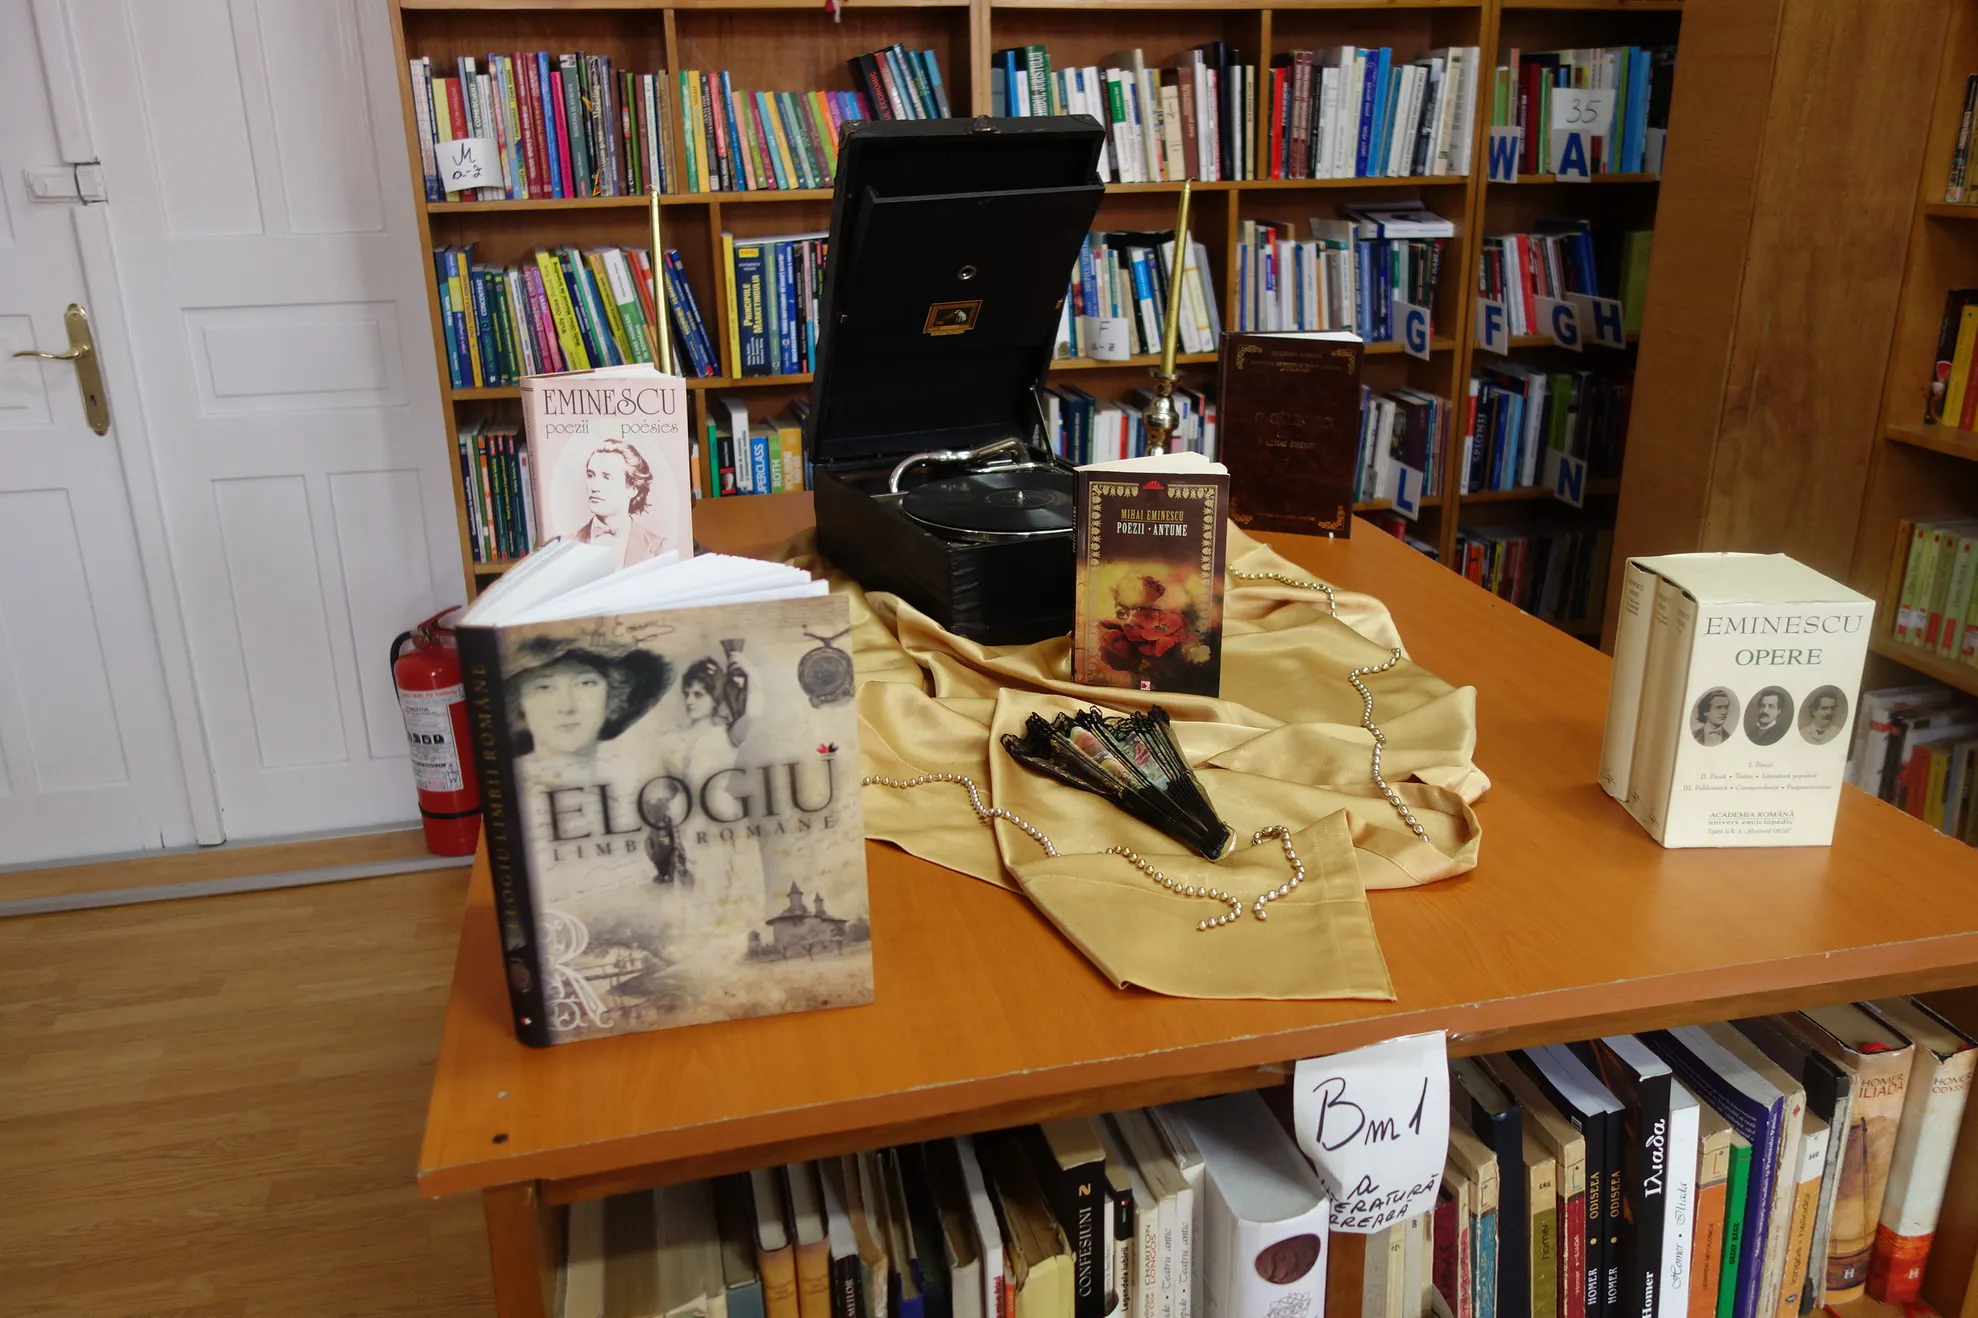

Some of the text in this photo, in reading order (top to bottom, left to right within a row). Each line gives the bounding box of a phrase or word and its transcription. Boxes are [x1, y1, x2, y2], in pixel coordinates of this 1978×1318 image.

[1566, 98, 1602, 123] 35
[1489, 136, 1518, 180] W
[1558, 132, 1588, 177] A
[476, 278, 487, 316] CONCENTRAT
[751, 274, 763, 334] MARKETINGULUI
[1406, 310, 1426, 353] G
[1485, 304, 1502, 346] F
[1552, 305, 1578, 346] G
[1592, 301, 1623, 344] H
[543, 387, 677, 416] EMINESCU
[545, 419, 679, 441] poezii poésies
[754, 444, 767, 494] UPERCLASS
[772, 459, 781, 487] ROTH
[1397, 468, 1413, 513] L
[1557, 457, 1583, 503] N
[1116, 521, 1188, 537] POEZII ANTUME
[1120, 508, 1184, 522] MIHAI EMINESCU
[1703, 614, 1864, 636] EMINESCU
[1735, 648, 1823, 666] OPERE
[541, 757, 836, 843] ELOGIU
[697, 814, 838, 845] ROMÂNE
[1858, 1082, 1904, 1098] ILIADA
[1861, 1073, 1904, 1086] HOMER
[1079, 1207, 1092, 1297] CONFESIUNI
[1178, 1222, 1188, 1287] Teatru antic
[1541, 1223, 1549, 1260] homer
[1588, 1171, 1600, 1305] HOMER ODISEEA
[1607, 1170, 1620, 1304] HOMER ODISEEA
[1670, 1181, 1688, 1290] Homer Iliada
[1121, 1247, 1130, 1312] Legendele iubirii
[1161, 1228, 1172, 1292] Teatru antic
[1642, 1271, 1654, 1318] Homer
